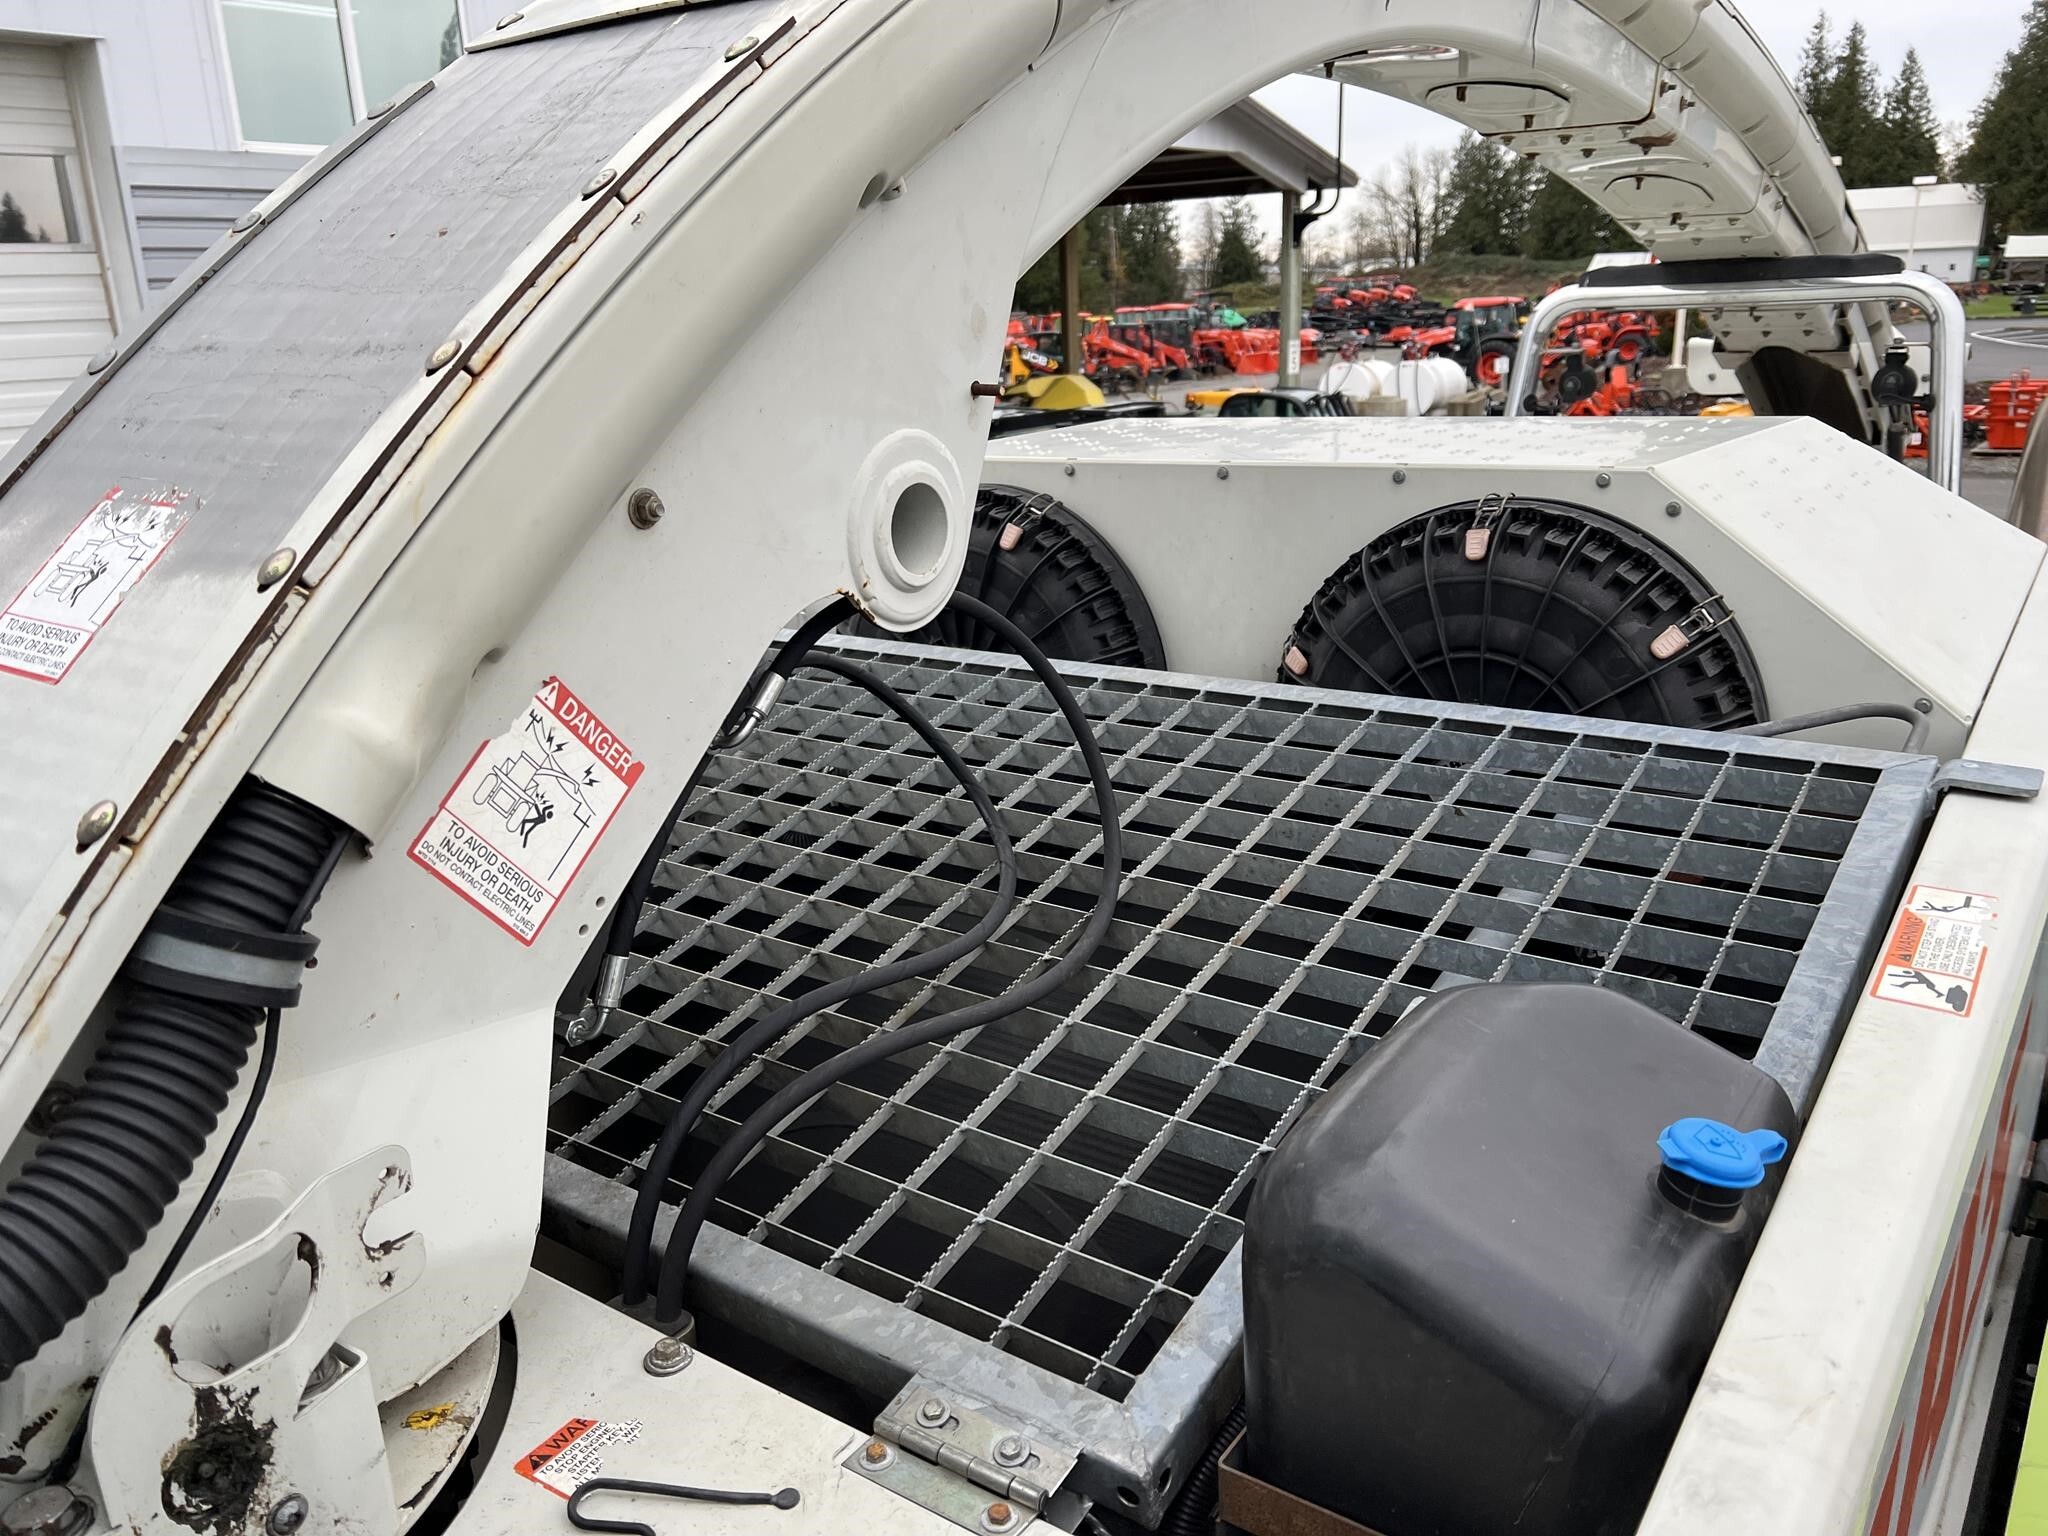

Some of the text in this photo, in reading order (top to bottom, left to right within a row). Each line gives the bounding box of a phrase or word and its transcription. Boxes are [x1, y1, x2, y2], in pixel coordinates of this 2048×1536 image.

[1022, 351, 1048, 366] JCB
[6, 618, 80, 644] TO AVOID SERIOUS
[25, 639, 41, 651] OR
[37, 642, 68, 657] DEATH
[559, 696, 632, 777] DANGER
[440, 836, 482, 873] INJURY
[480, 869, 499, 888] OR
[497, 882, 533, 915] DEATH
[447, 820, 465, 839] TO
[463, 836, 498, 866] AVOID
[497, 861, 543, 903] SERIOUS
[421, 840, 434, 853] DO
[433, 850, 452, 866] NOT
[450, 863, 484, 892] CONTACT
[482, 888, 516, 917] ELECTRIC
[514, 911, 536, 932] LINES
[1895, 917, 1924, 952] WARNING
[555, 1454, 578, 1474] STOP
[579, 1426, 614, 1453] ENGINE,
[621, 1421, 643, 1438] WAIT
[540, 1464, 554, 1475] TO
[554, 1442, 581, 1465] AVOID
[568, 1442, 607, 1474] STARTER
[605, 1427, 627, 1442] KEY,
